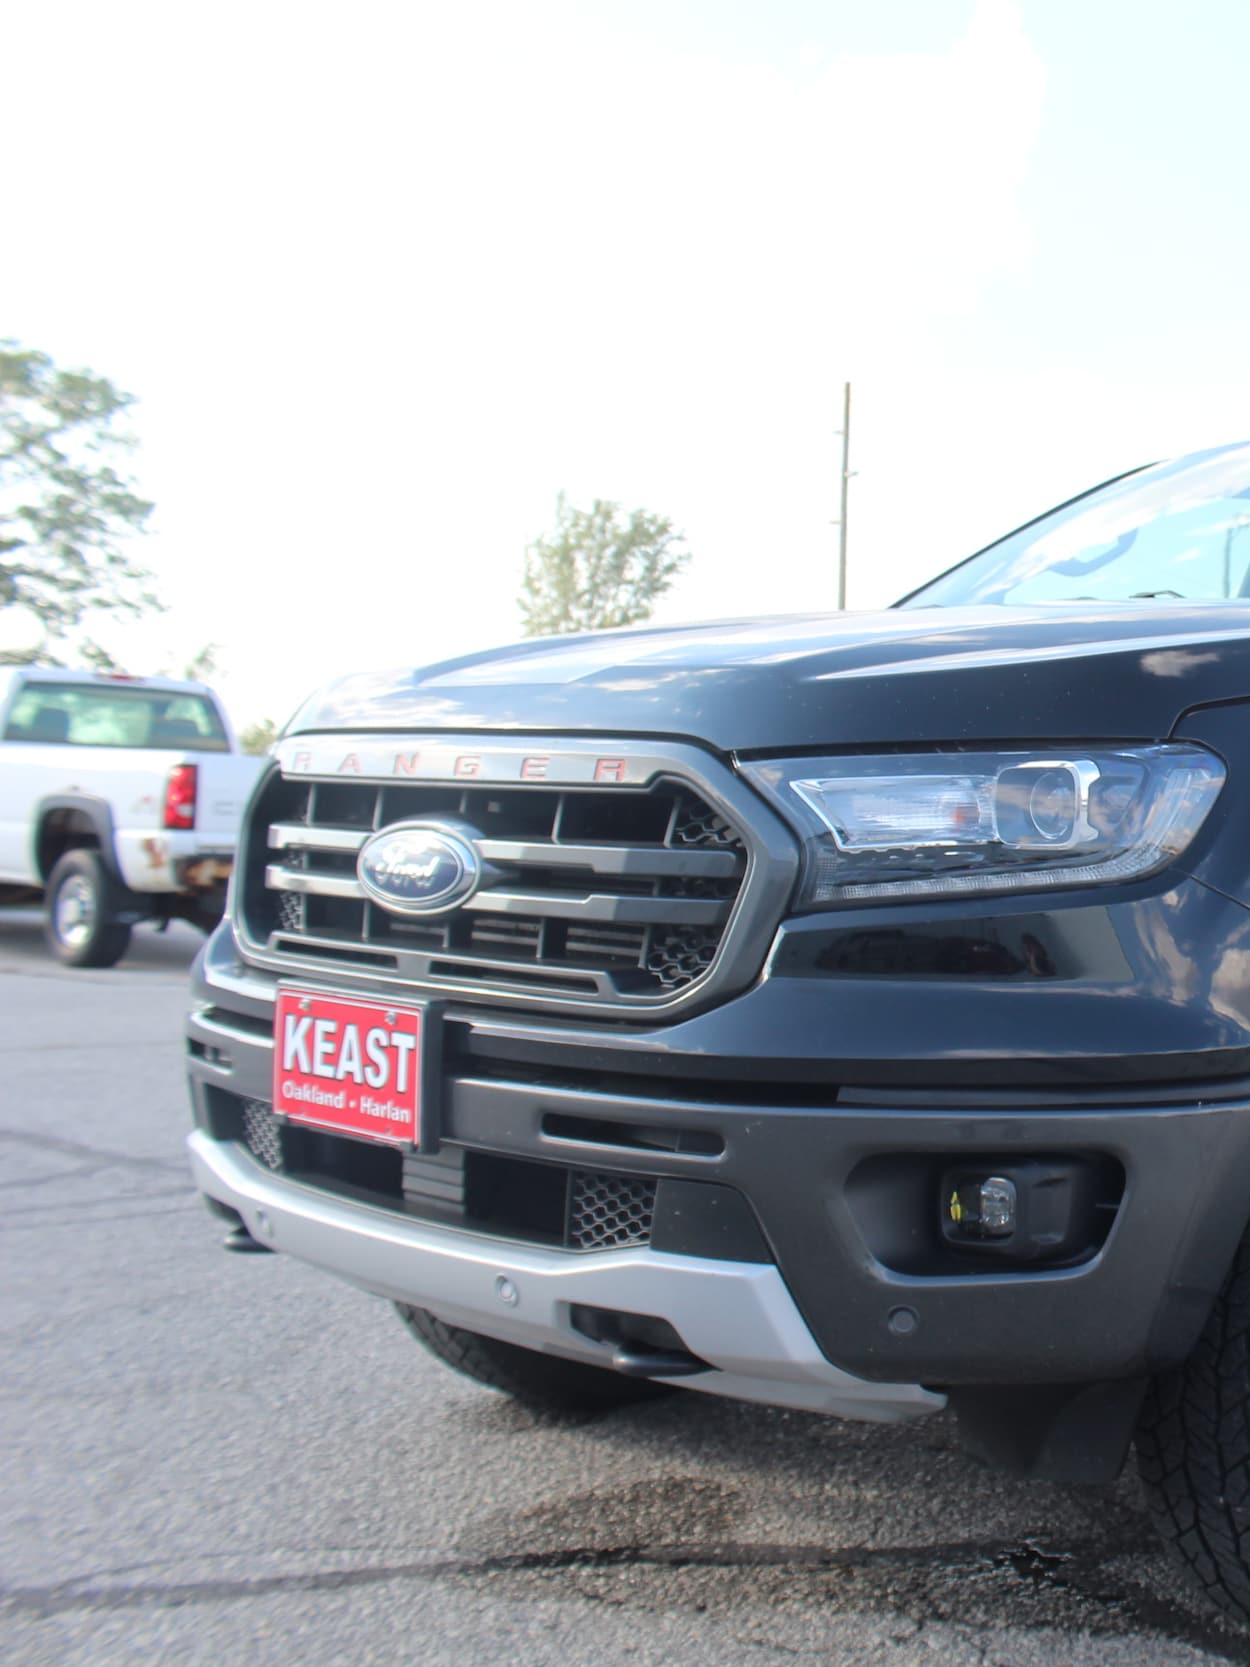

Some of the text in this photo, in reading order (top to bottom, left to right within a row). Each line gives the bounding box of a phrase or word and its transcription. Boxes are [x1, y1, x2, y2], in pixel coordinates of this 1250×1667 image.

[291, 750, 627, 783] RANGER
[374, 840, 441, 888] Ford
[283, 1013, 417, 1093] KEAST
[282, 1080, 412, 1124] Oakland Harlan
